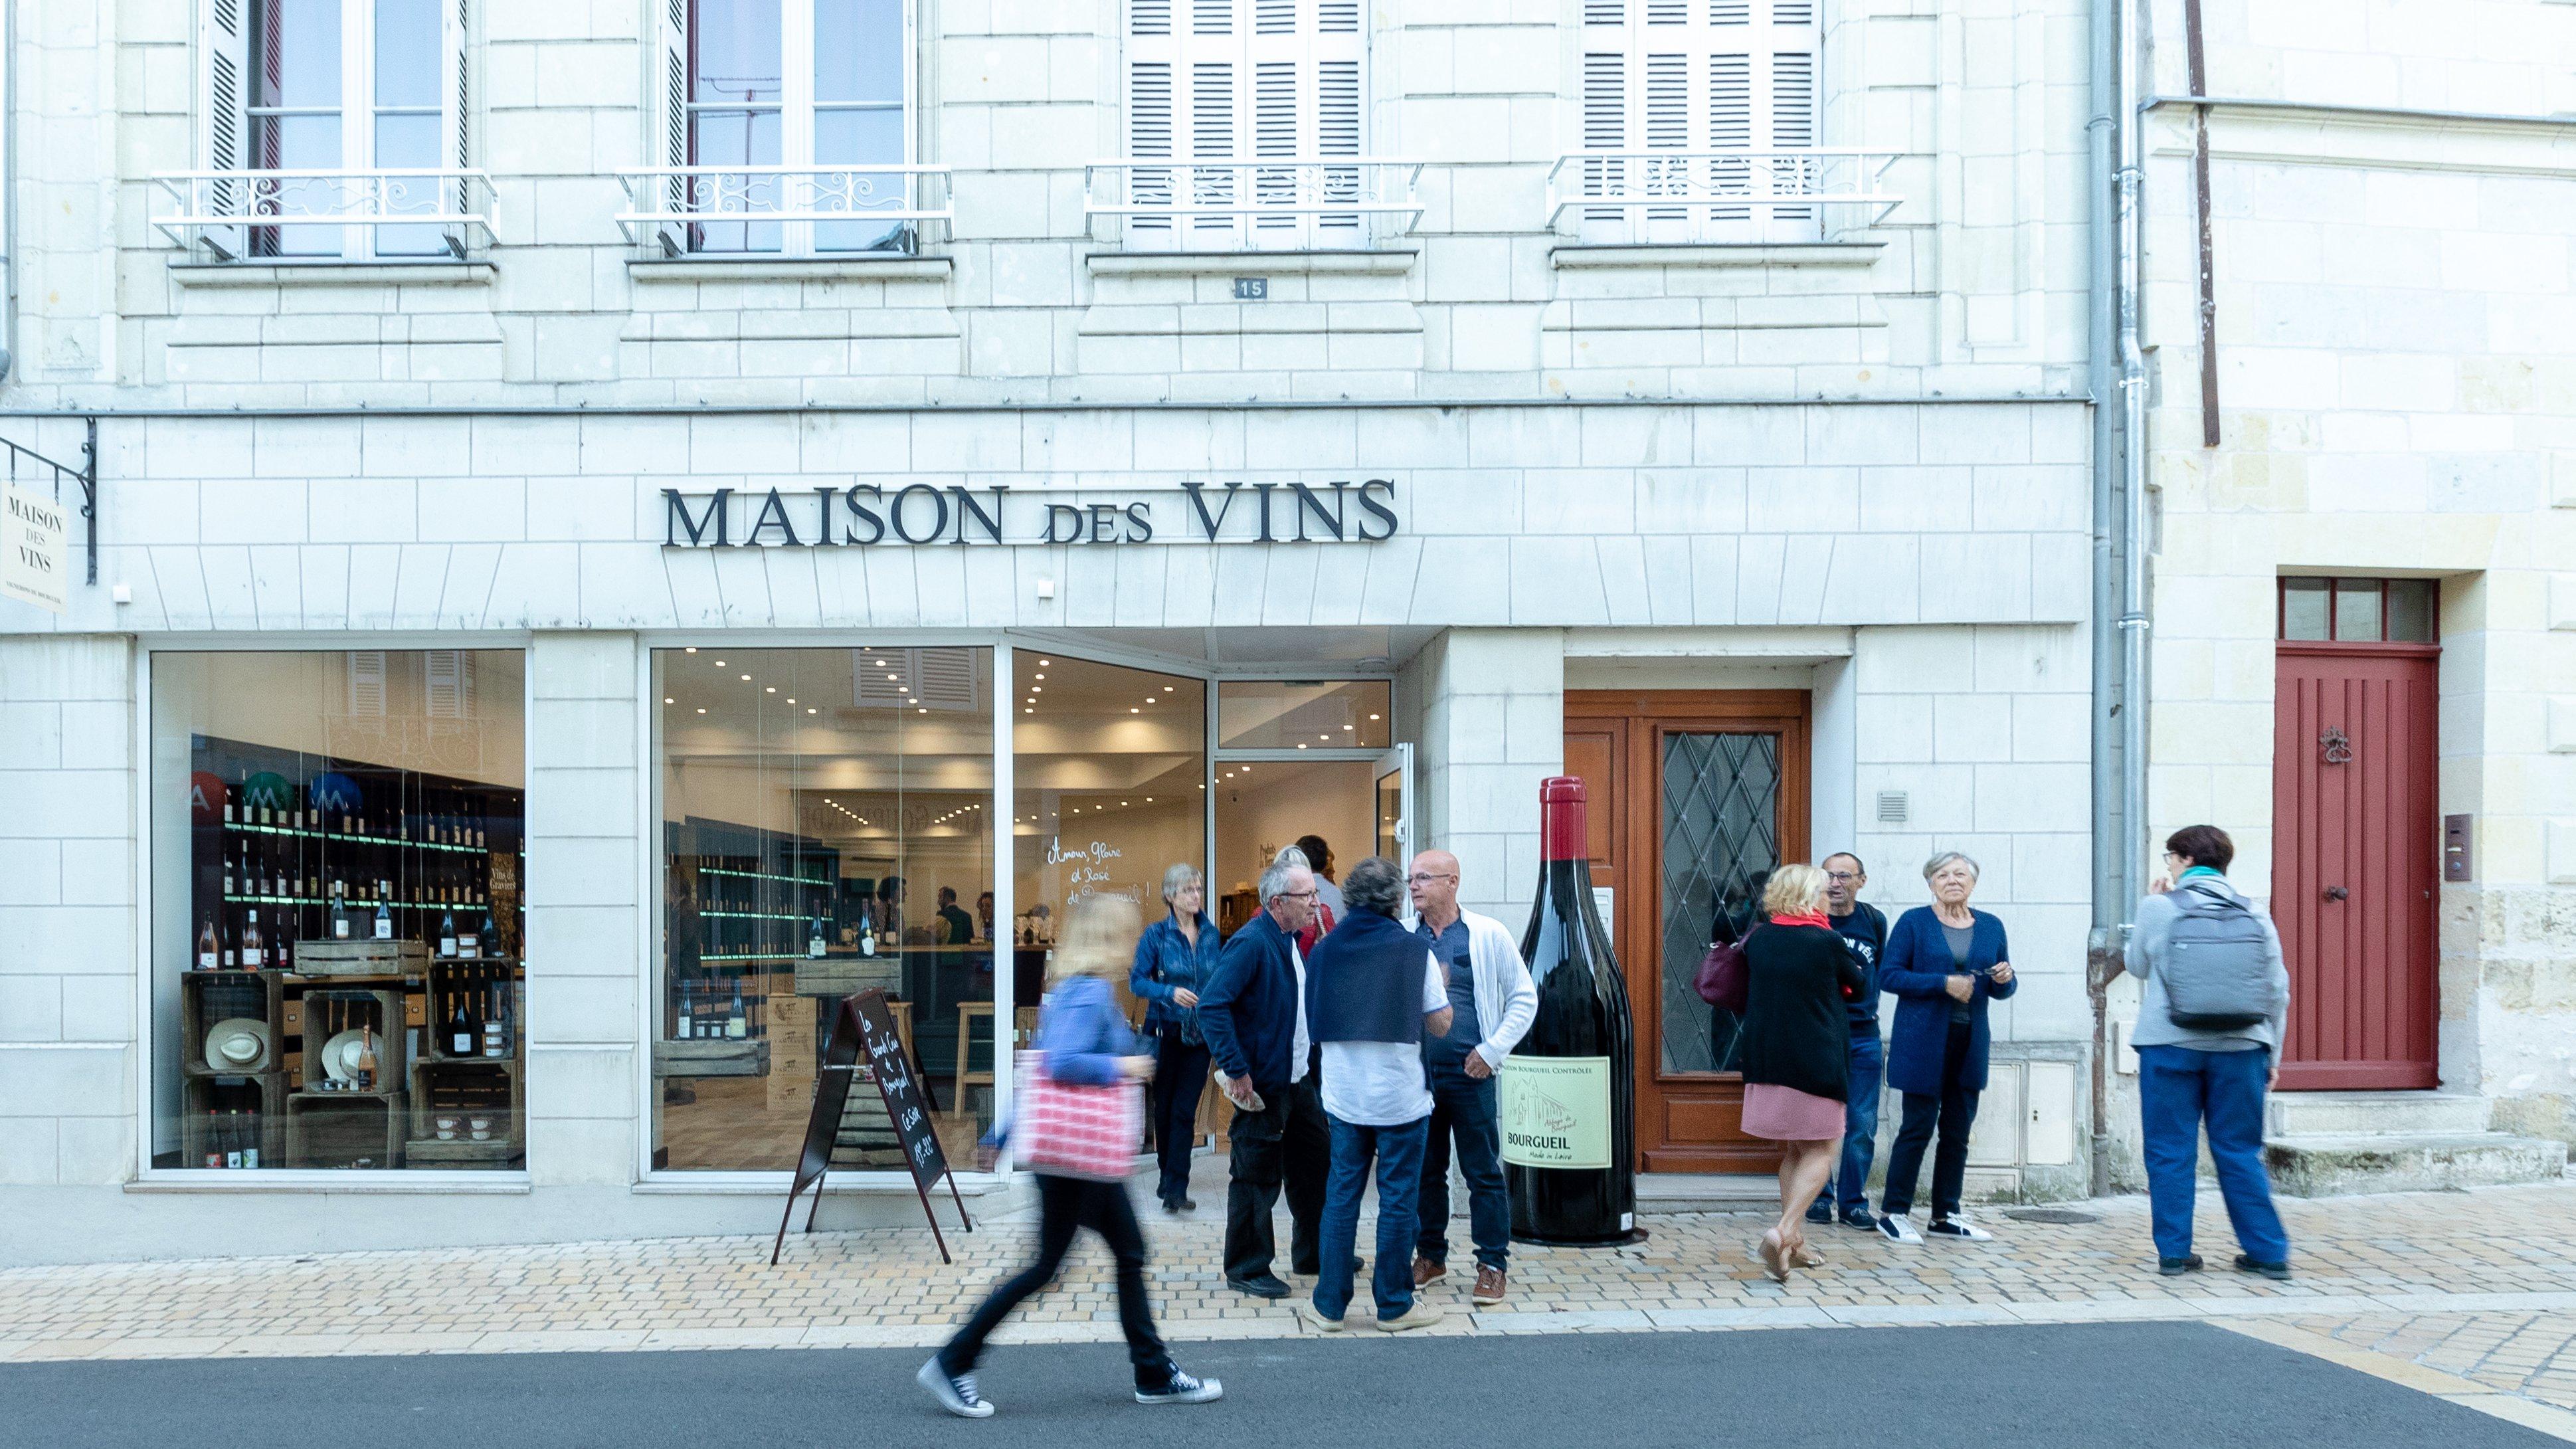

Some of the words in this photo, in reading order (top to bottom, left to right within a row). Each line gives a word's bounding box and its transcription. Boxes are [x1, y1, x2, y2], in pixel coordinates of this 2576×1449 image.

[1241, 281, 1262, 296] 15
[8, 495, 63, 533] MAISON
[660, 484, 1010, 547] MAISON
[1040, 501, 1152, 545] DES
[1180, 478, 1399, 543] VINS
[25, 528, 46, 546] DES
[19, 545, 51, 573] VINS
[1083, 866, 1111, 883] Rosé
[1067, 890, 1079, 905] de
[1508, 1132, 1571, 1150] BOURGUEIL
